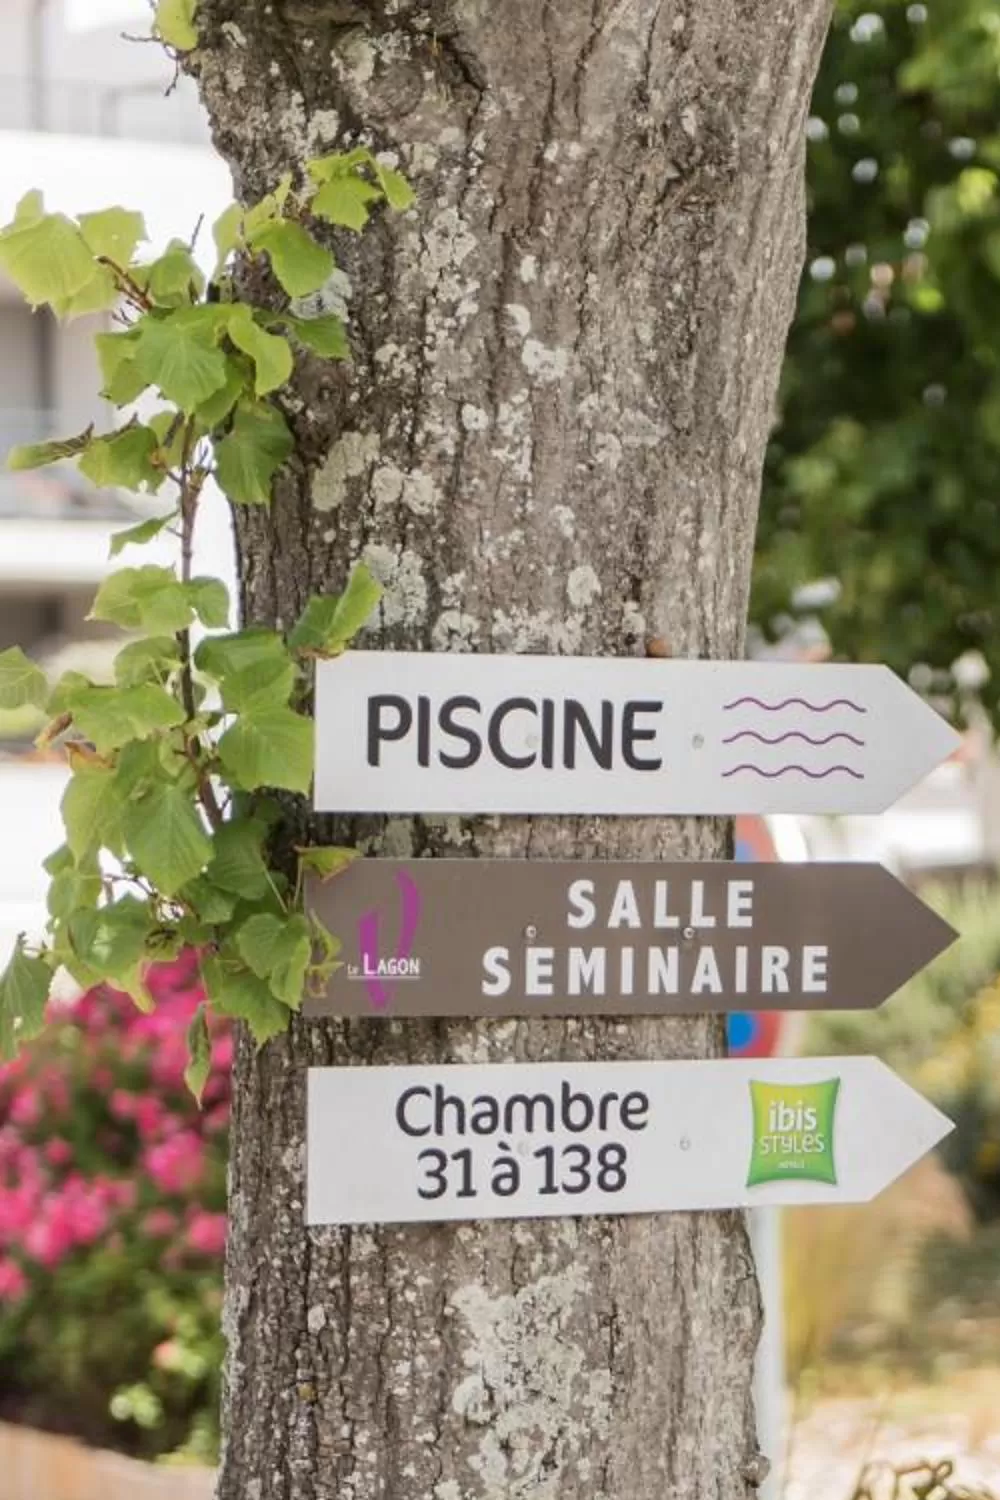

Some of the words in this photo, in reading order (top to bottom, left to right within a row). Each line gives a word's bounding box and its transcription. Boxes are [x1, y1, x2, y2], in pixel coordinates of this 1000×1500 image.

[366, 694, 664, 771] PISCINE
[566, 879, 756, 929] SALLE
[395, 1081, 650, 1137] Chambre
[769, 1099, 818, 1133] ibis
[416, 1148, 476, 1199] 31
[491, 1142, 521, 1196] à
[533, 1143, 628, 1195] 138
